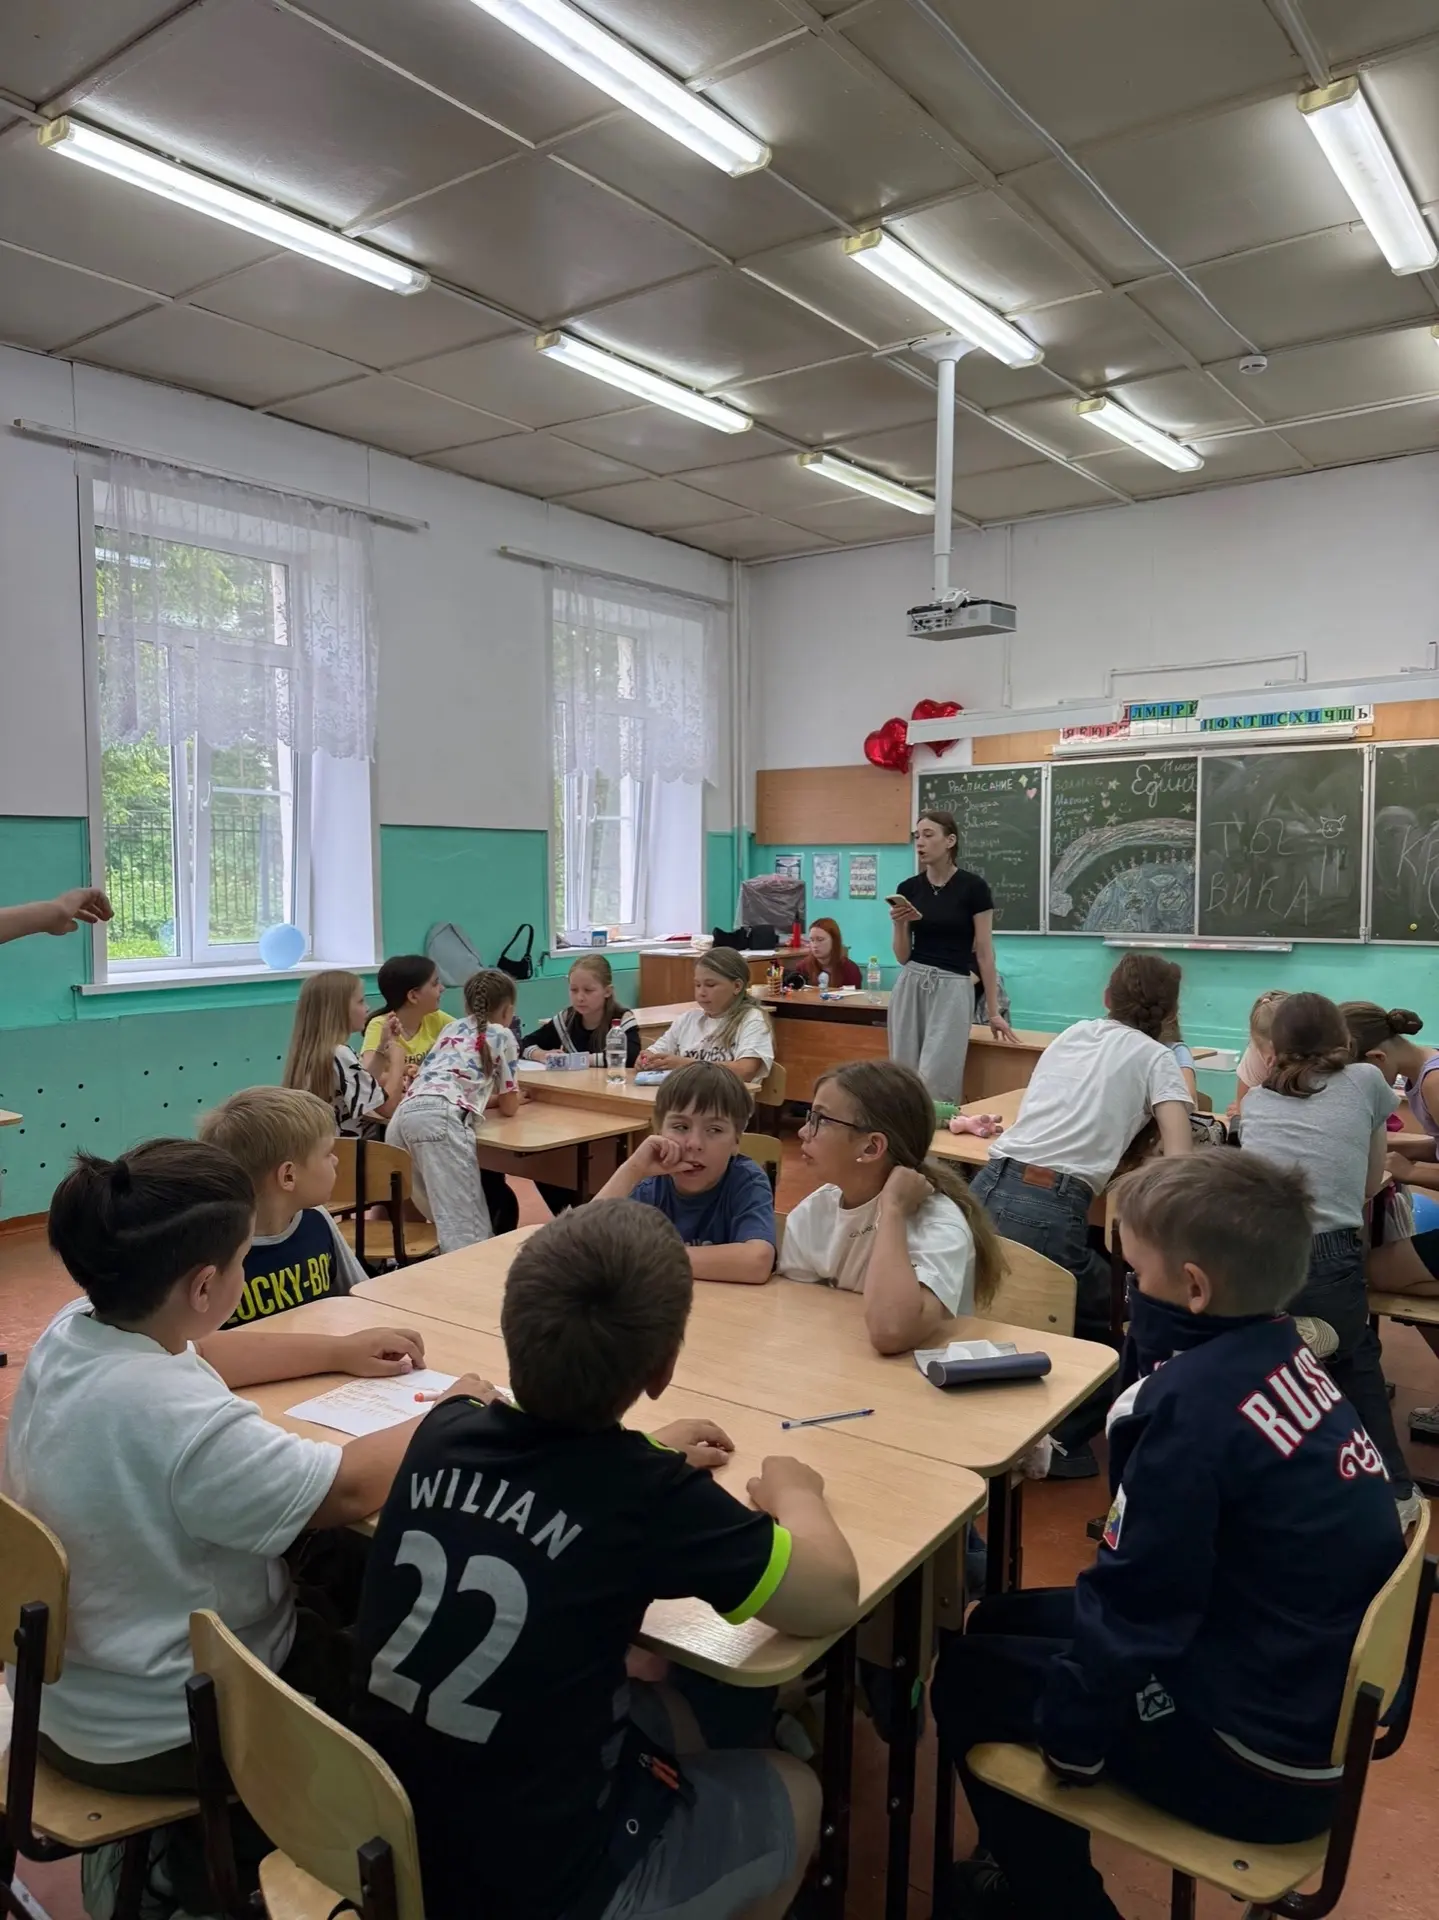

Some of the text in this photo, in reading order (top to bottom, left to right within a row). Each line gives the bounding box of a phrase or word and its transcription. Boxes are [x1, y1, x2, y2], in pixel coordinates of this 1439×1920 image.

[1205, 871, 1309, 926] ВИКА
[227, 1253, 331, 1324] OCKY-BO
[411, 1468, 583, 1560] WILIAN
[368, 1530, 528, 1744] 22
